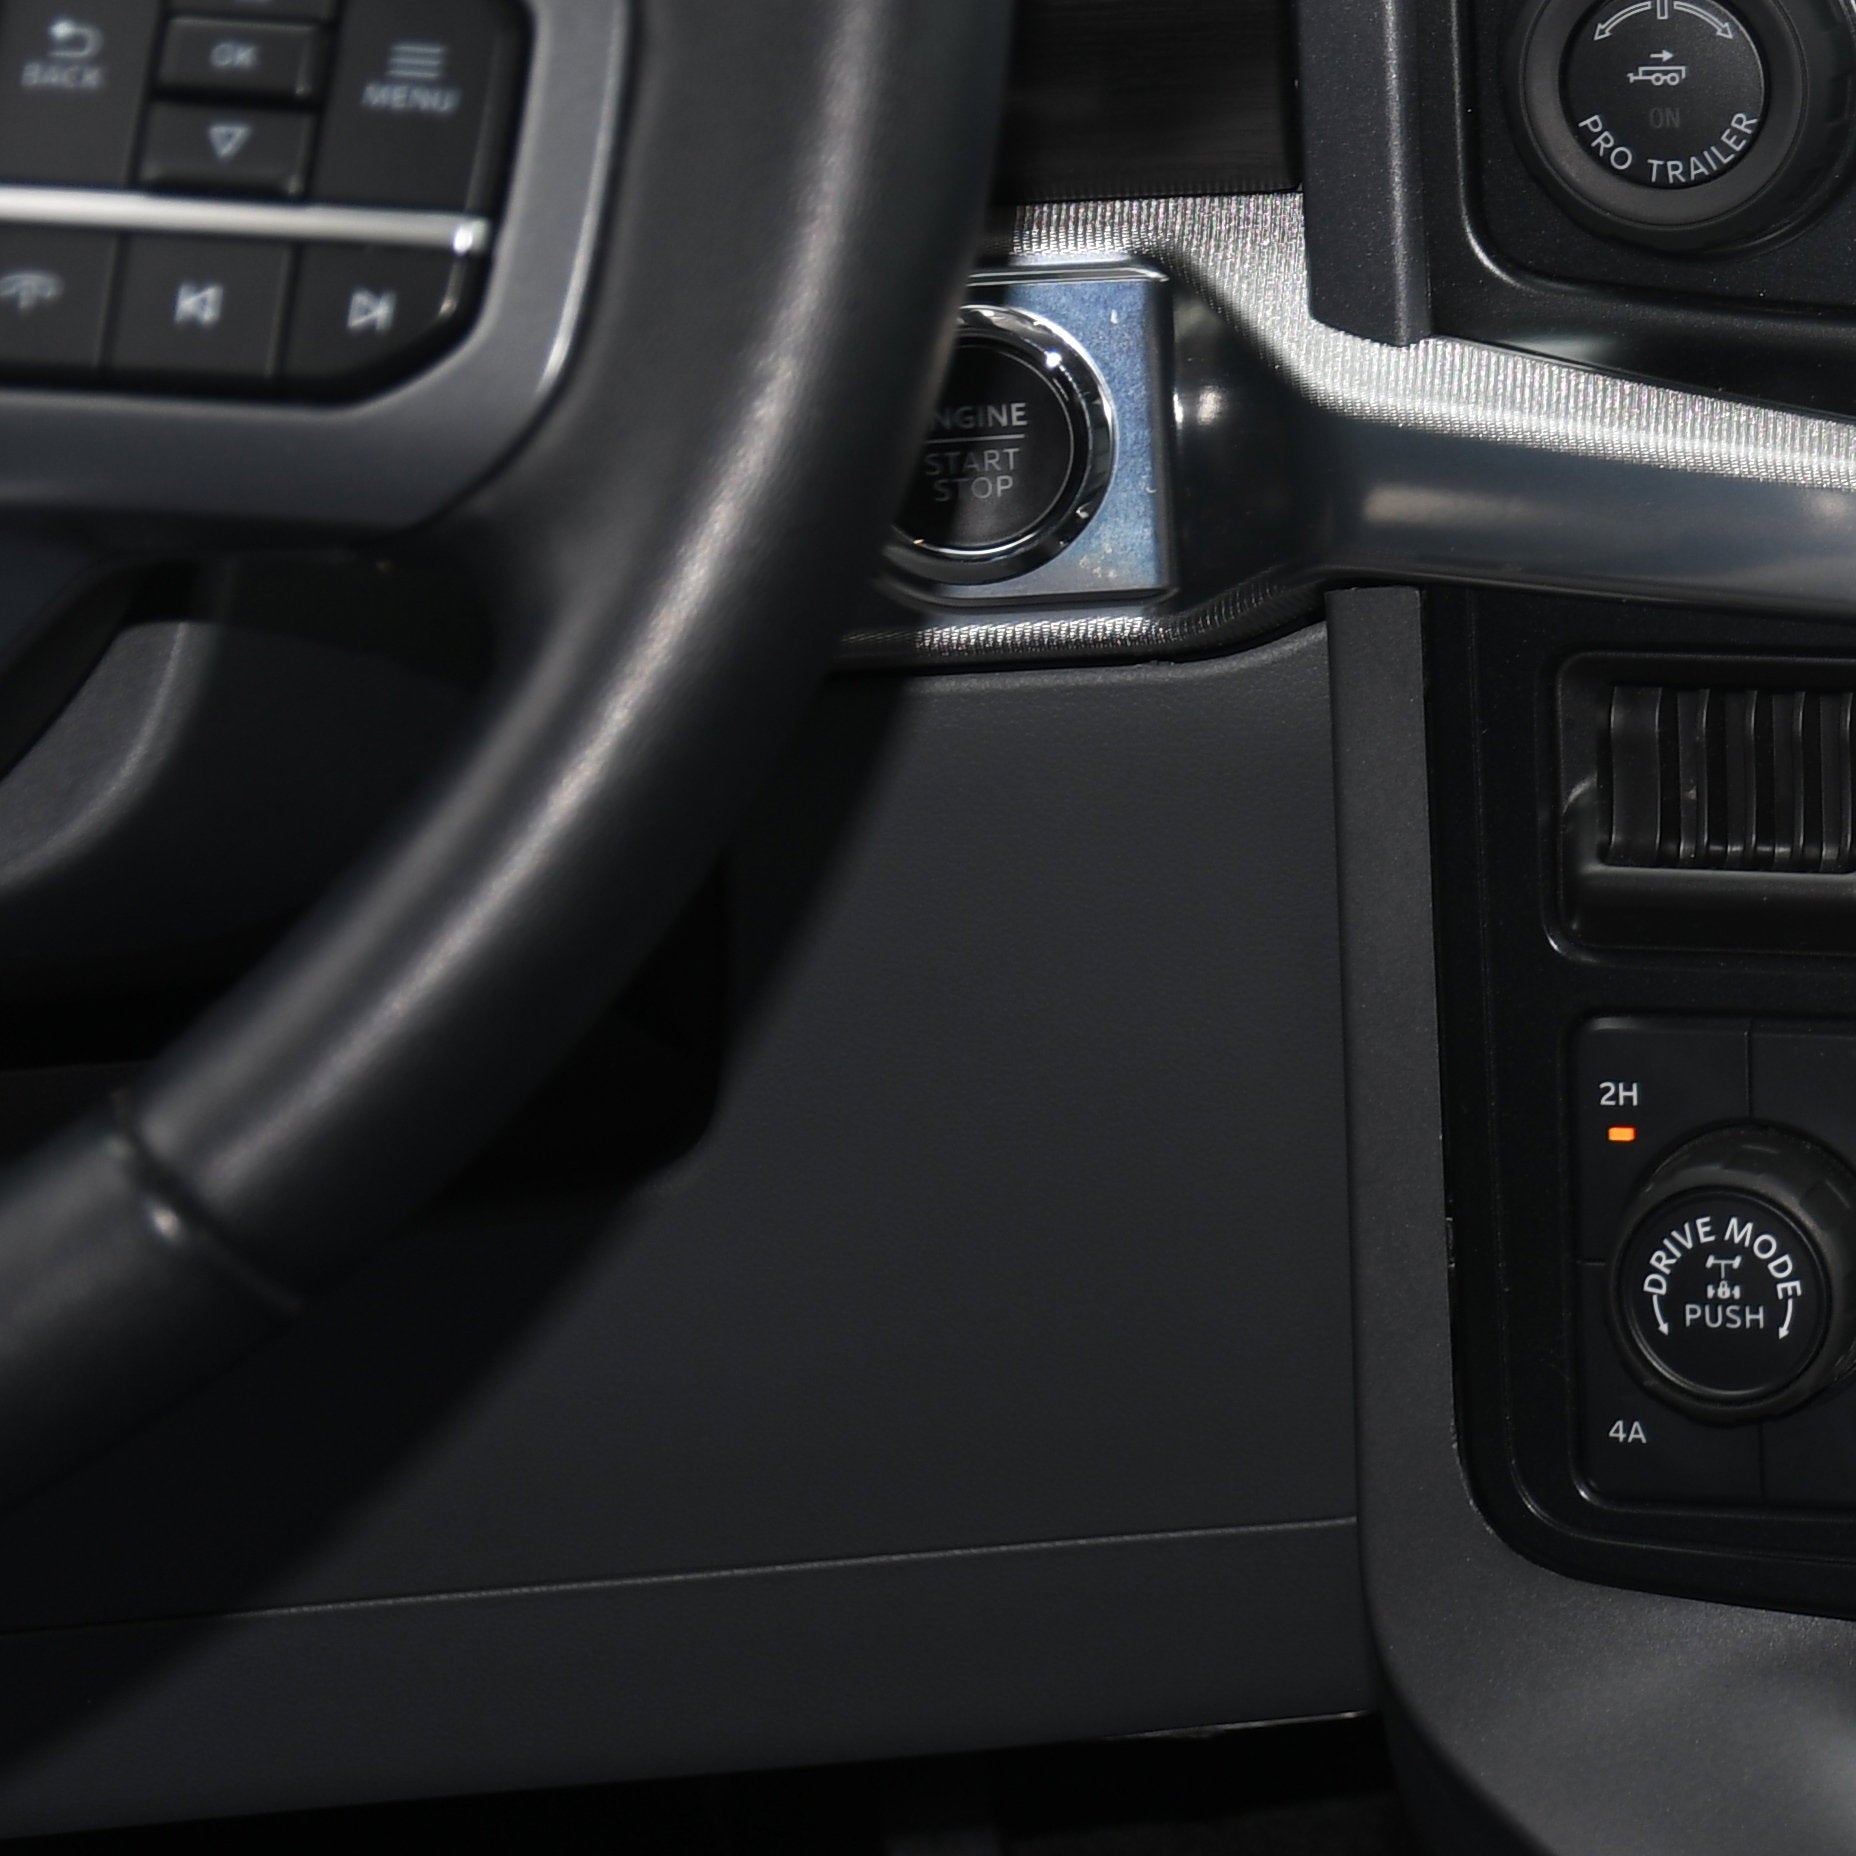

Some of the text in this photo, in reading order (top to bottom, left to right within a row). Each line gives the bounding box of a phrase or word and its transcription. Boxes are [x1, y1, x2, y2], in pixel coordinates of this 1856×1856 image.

[210, 44, 256, 67] OK
[23, 63, 102, 89] BACK
[364, 84, 456, 112] MENU
[1579, 113, 1758, 183] PRO TRAILER
[924, 448, 1020, 475] START
[933, 475, 1014, 501] STOP
[1599, 1083, 1638, 1107] 2H
[1643, 1217, 1801, 1299] DRIVE MODE
[1685, 1305, 1764, 1329] PUSH
[1608, 1420, 1646, 1444] 4A
